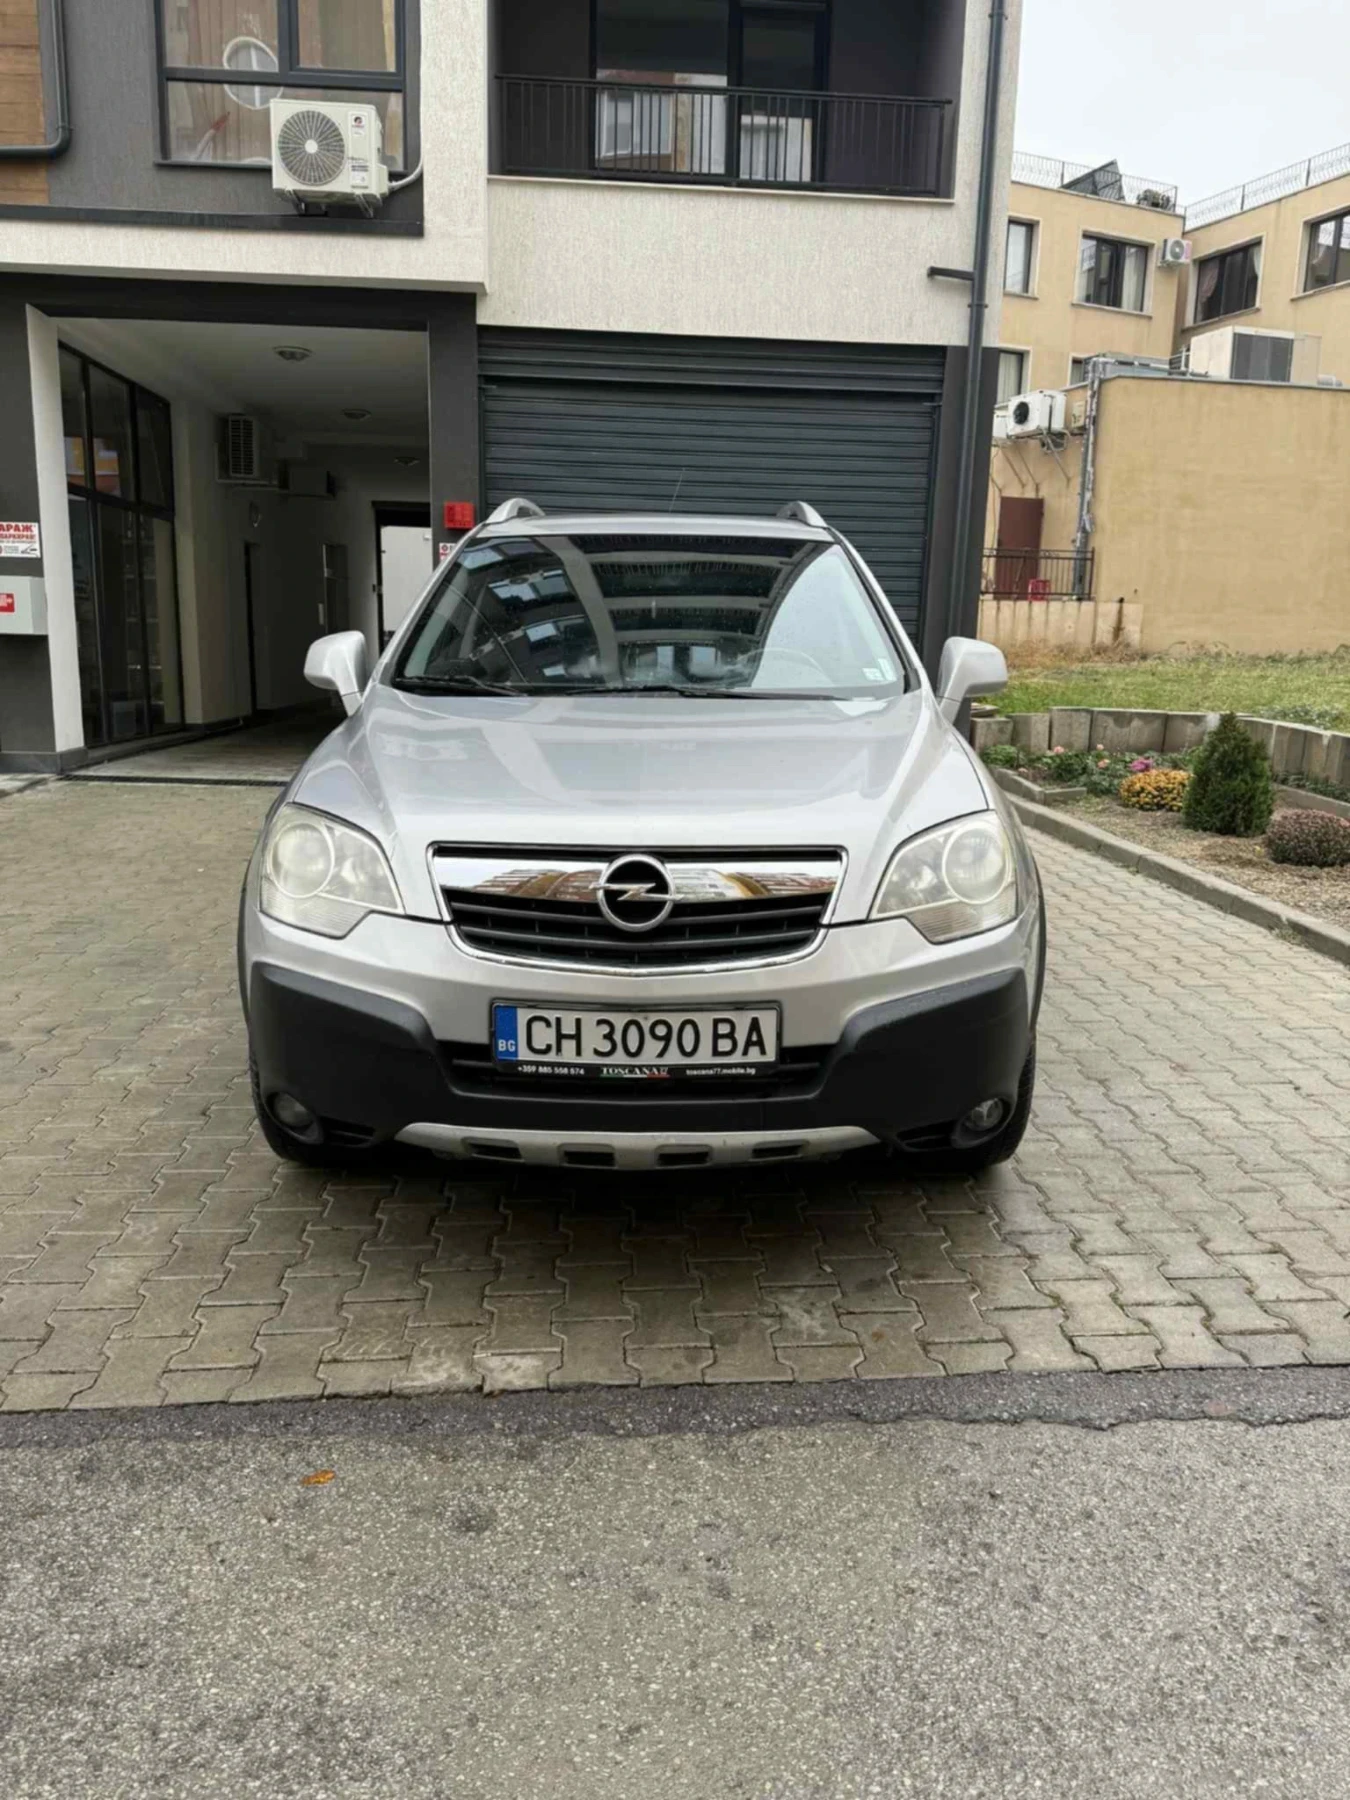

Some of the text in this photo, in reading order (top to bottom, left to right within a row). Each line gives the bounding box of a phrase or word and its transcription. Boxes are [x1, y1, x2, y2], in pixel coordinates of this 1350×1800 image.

[525, 1015, 766, 1058] CH 3090 BA
[498, 1039, 515, 1052] BG
[517, 1065, 536, 1073] +359
